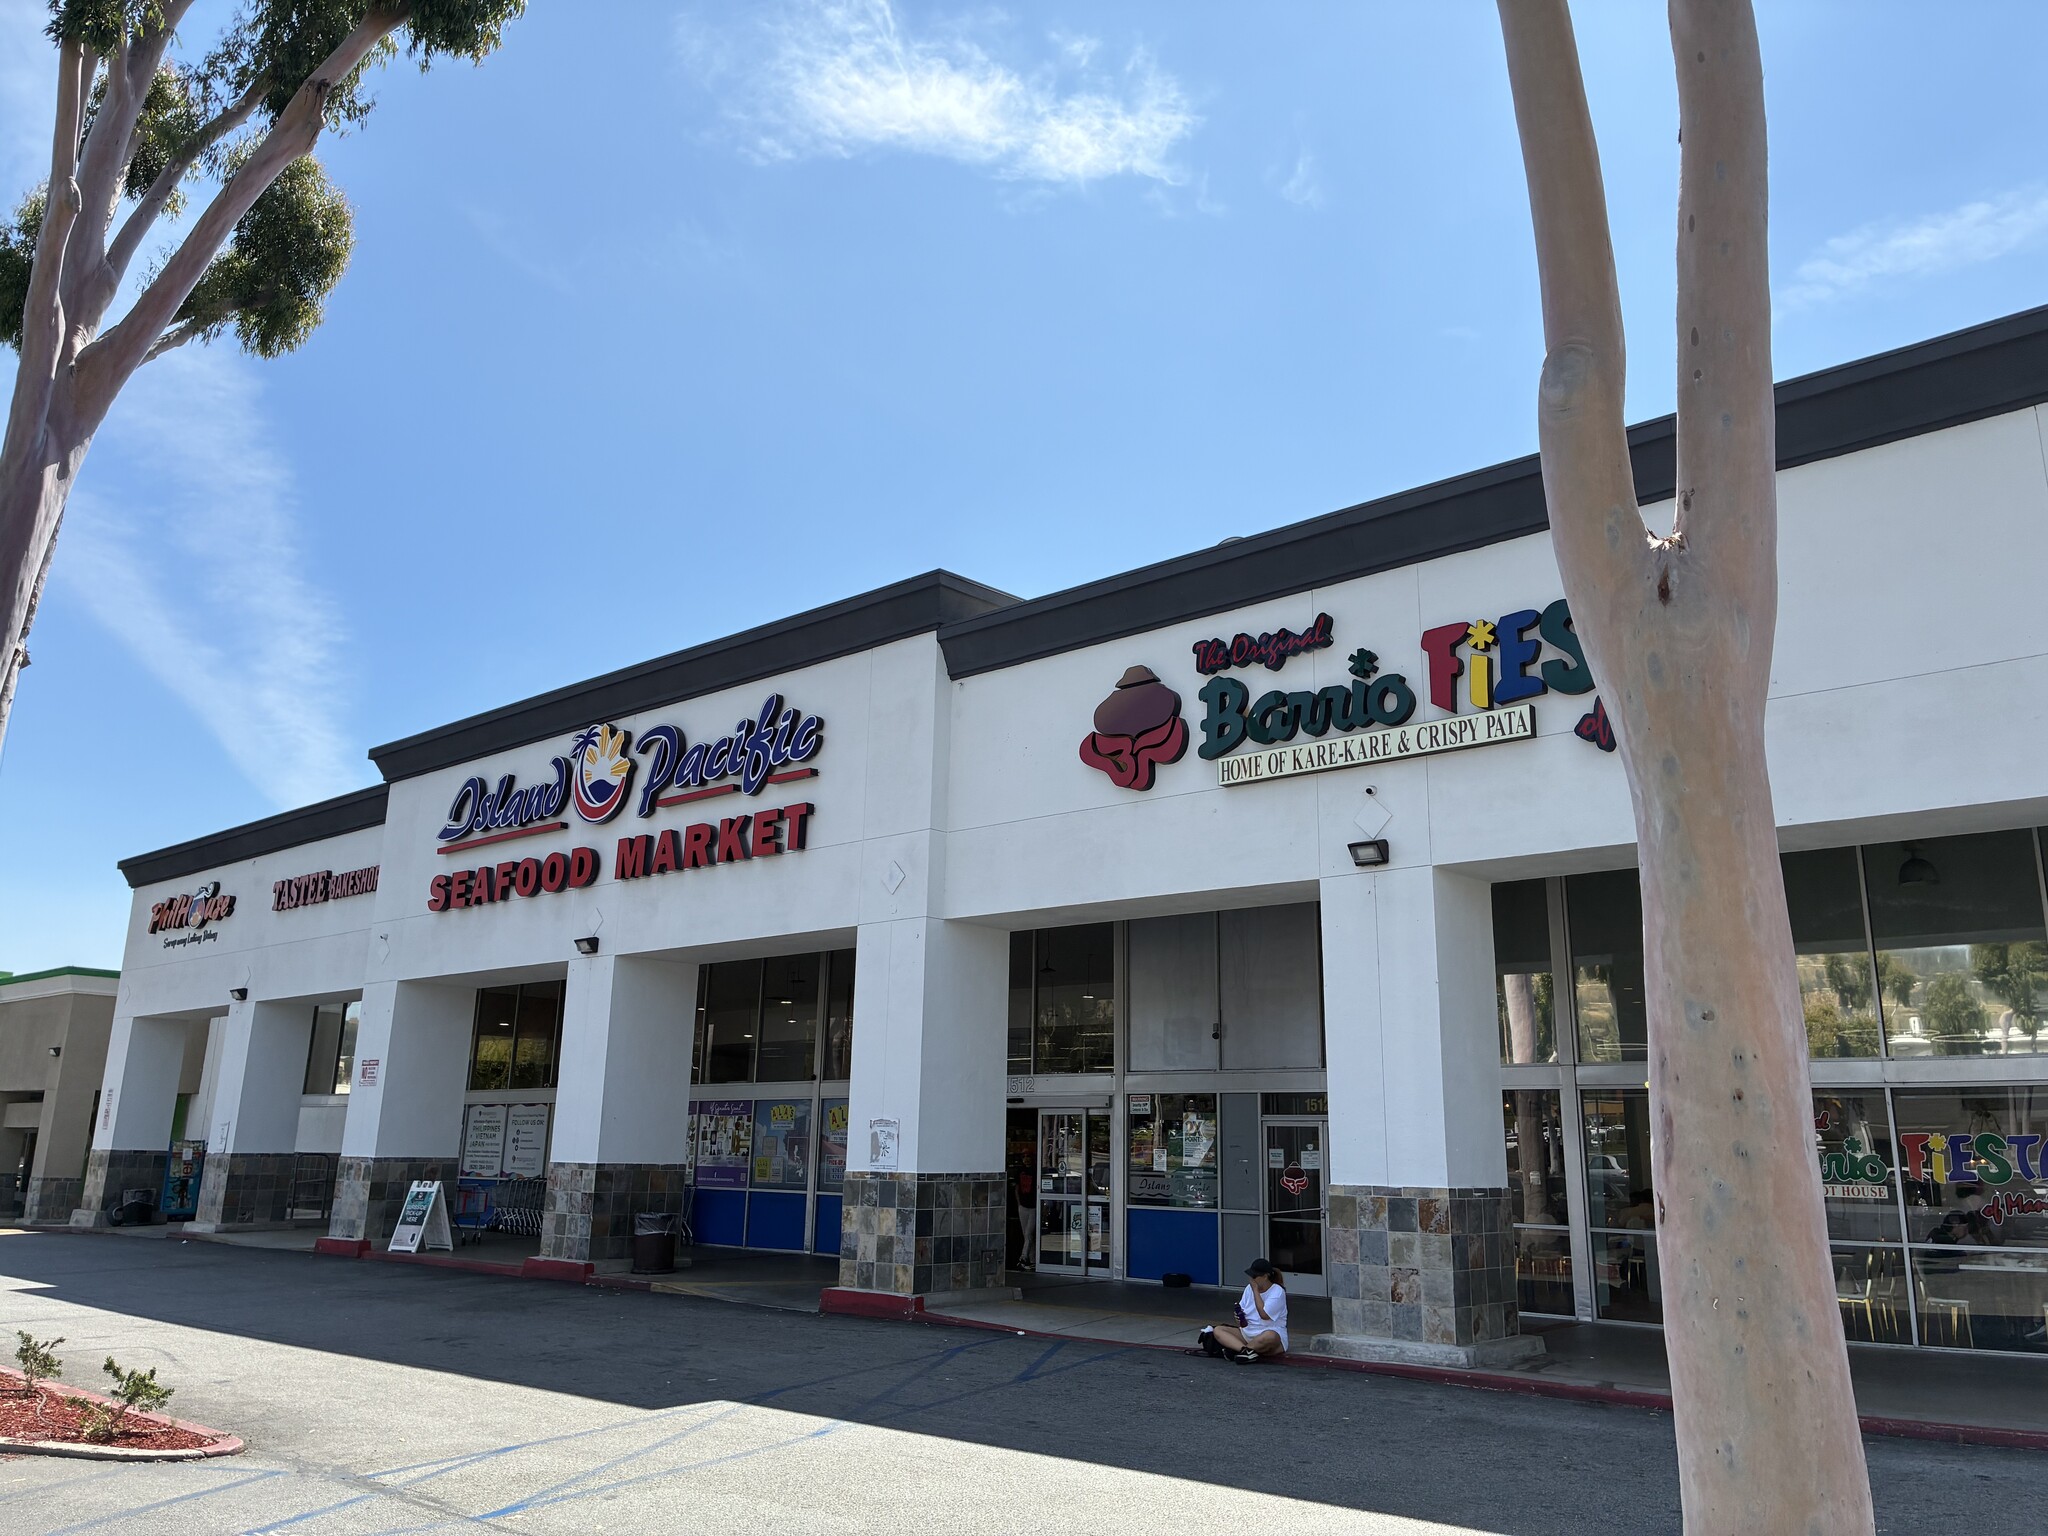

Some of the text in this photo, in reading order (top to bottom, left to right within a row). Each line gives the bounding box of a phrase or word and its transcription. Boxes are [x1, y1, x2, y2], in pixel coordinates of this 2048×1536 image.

[1193, 613, 1332, 674] The Original
[1198, 648, 1416, 760] Barrio
[436, 693, 824, 842] Island Pacific
[1221, 709, 1529, 782] HOME OF KARE-KARE & CRISPY PATA
[272, 870, 332, 911] TASTEE
[427, 802, 814, 912] SEAFOOD MARKET
[1842, 1185, 1887, 1198] HOUSE
